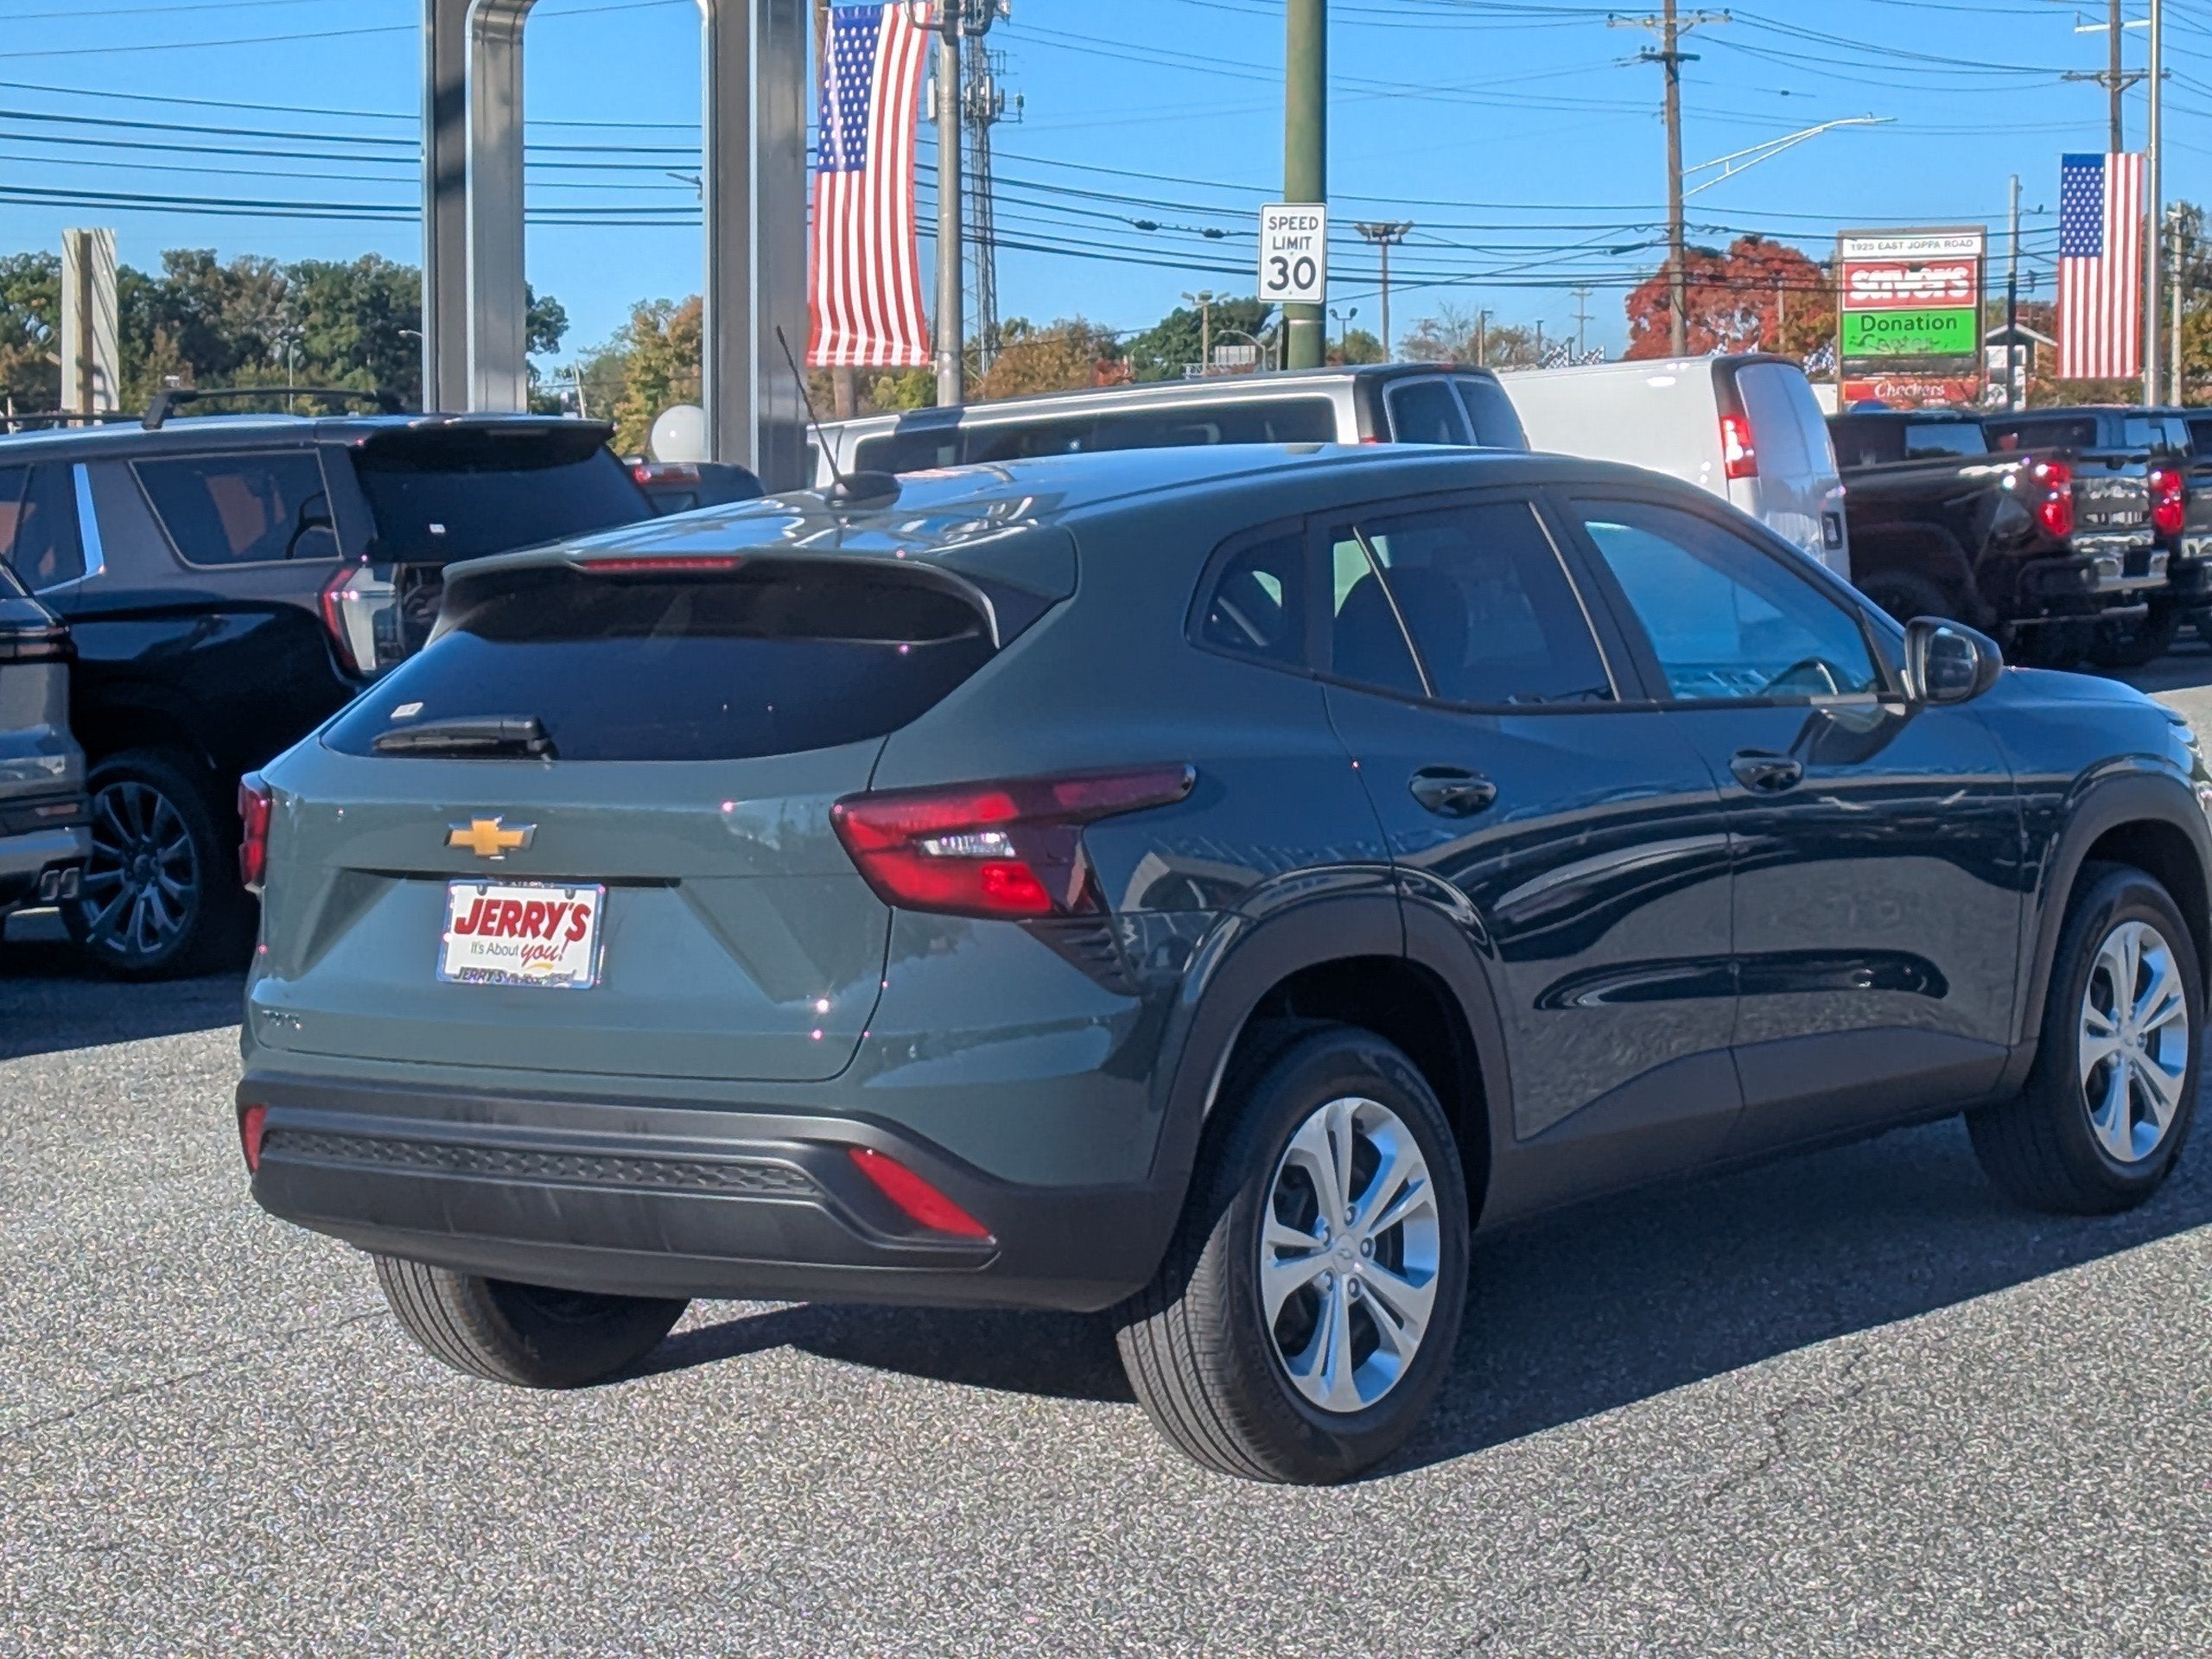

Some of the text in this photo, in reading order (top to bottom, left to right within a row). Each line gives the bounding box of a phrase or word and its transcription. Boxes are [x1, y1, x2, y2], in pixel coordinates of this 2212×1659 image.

[1268, 215, 1319, 232] SPEED
[1272, 236, 1313, 251] LIMIT
[1878, 241, 1904, 251] EAST
[1907, 240, 1941, 250] JOPPA
[1944, 238, 1974, 248] ROAD
[1267, 255, 1317, 291] 30
[1860, 313, 1958, 333] Donation
[454, 899, 592, 942] JERRY'S
[471, 939, 570, 968] It's About you!
